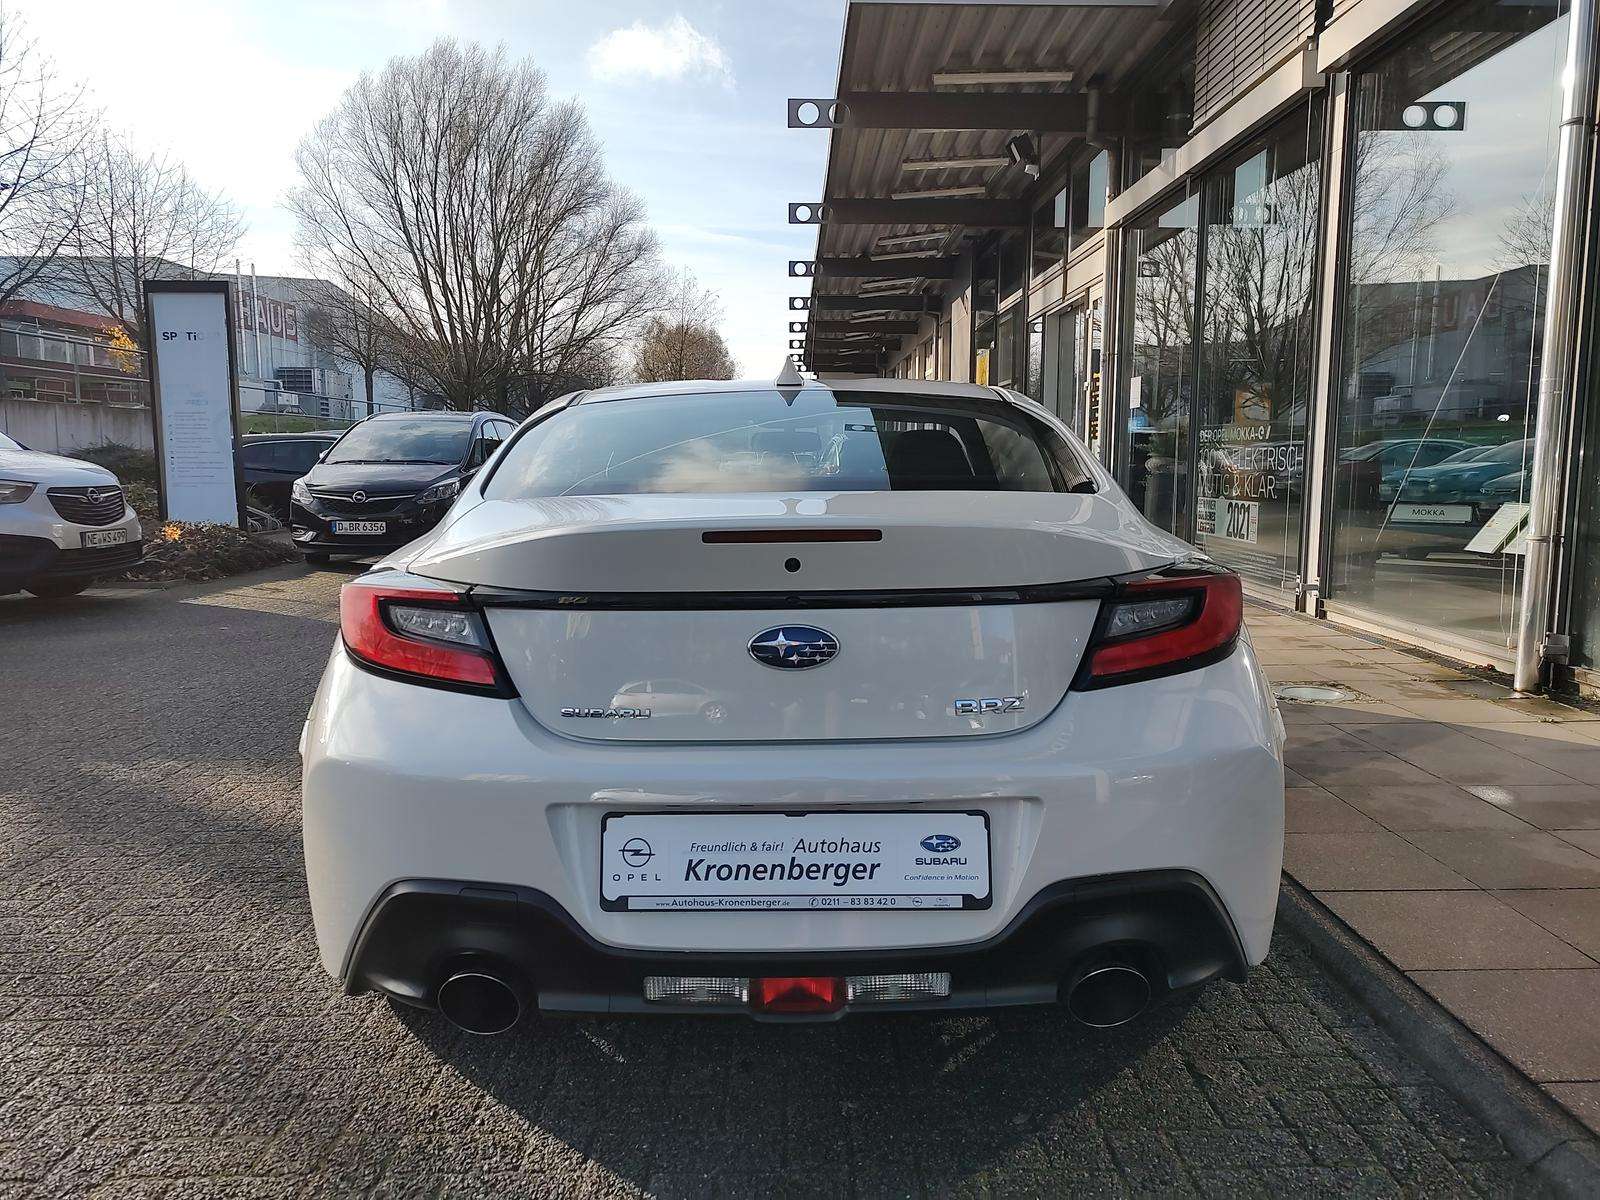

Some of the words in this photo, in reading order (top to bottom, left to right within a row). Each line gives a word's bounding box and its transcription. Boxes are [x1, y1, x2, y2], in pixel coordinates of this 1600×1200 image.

[1233, 446, 1304, 472] ELEKTRISCH
[1232, 474, 1241, 496] &
[349, 522, 360, 531] BR
[362, 522, 384, 531] 6356
[1227, 501, 1250, 540] 2021
[955, 697, 1024, 716] BRZ
[560, 708, 651, 719] SUBARU
[690, 842, 747, 852] Freundlich
[750, 842, 758, 852] &
[761, 842, 784, 852] fair!
[792, 837, 882, 853] Autohaus
[915, 857, 967, 866] SUBARU
[612, 874, 662, 882] OPEL
[684, 857, 881, 887] Kronenberger
[821, 897, 840, 906] 0211
[850, 897, 861, 906] 83
[864, 897, 875, 906] 83
[877, 897, 888, 906] 42
[890, 897, 896, 906] 0
